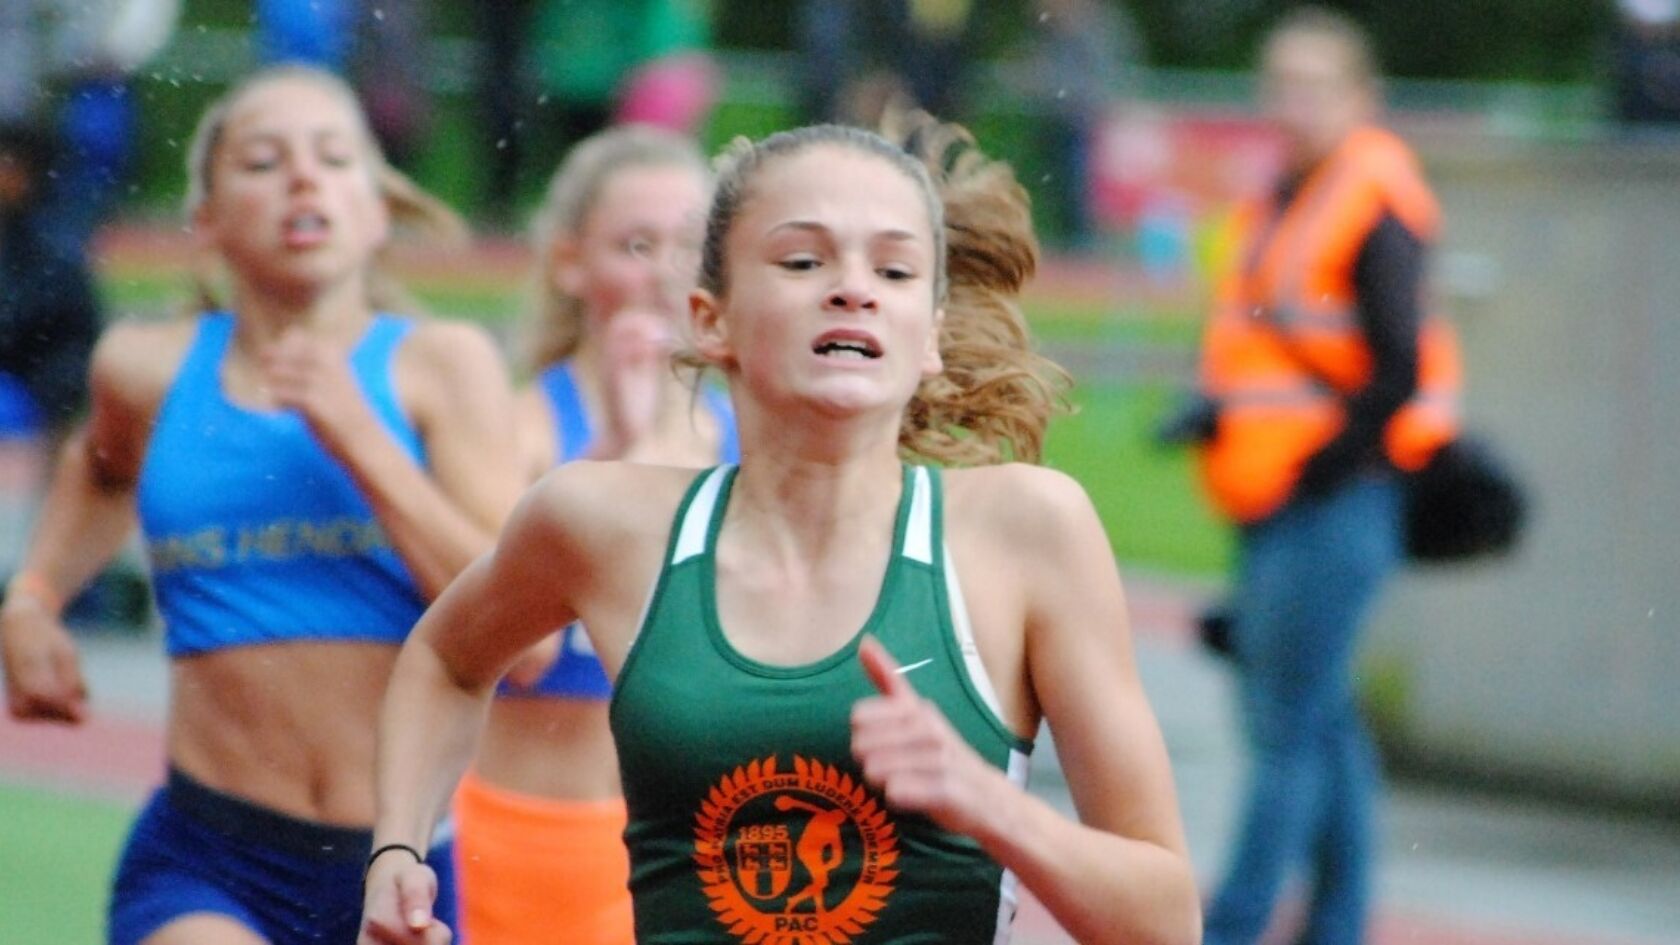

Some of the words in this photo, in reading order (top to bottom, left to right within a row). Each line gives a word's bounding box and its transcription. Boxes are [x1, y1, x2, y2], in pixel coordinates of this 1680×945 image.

[732, 784, 757, 806] EST
[763, 778, 799, 790] DUM
[739, 824, 788, 840] 1895
[774, 916, 819, 932] PAC
